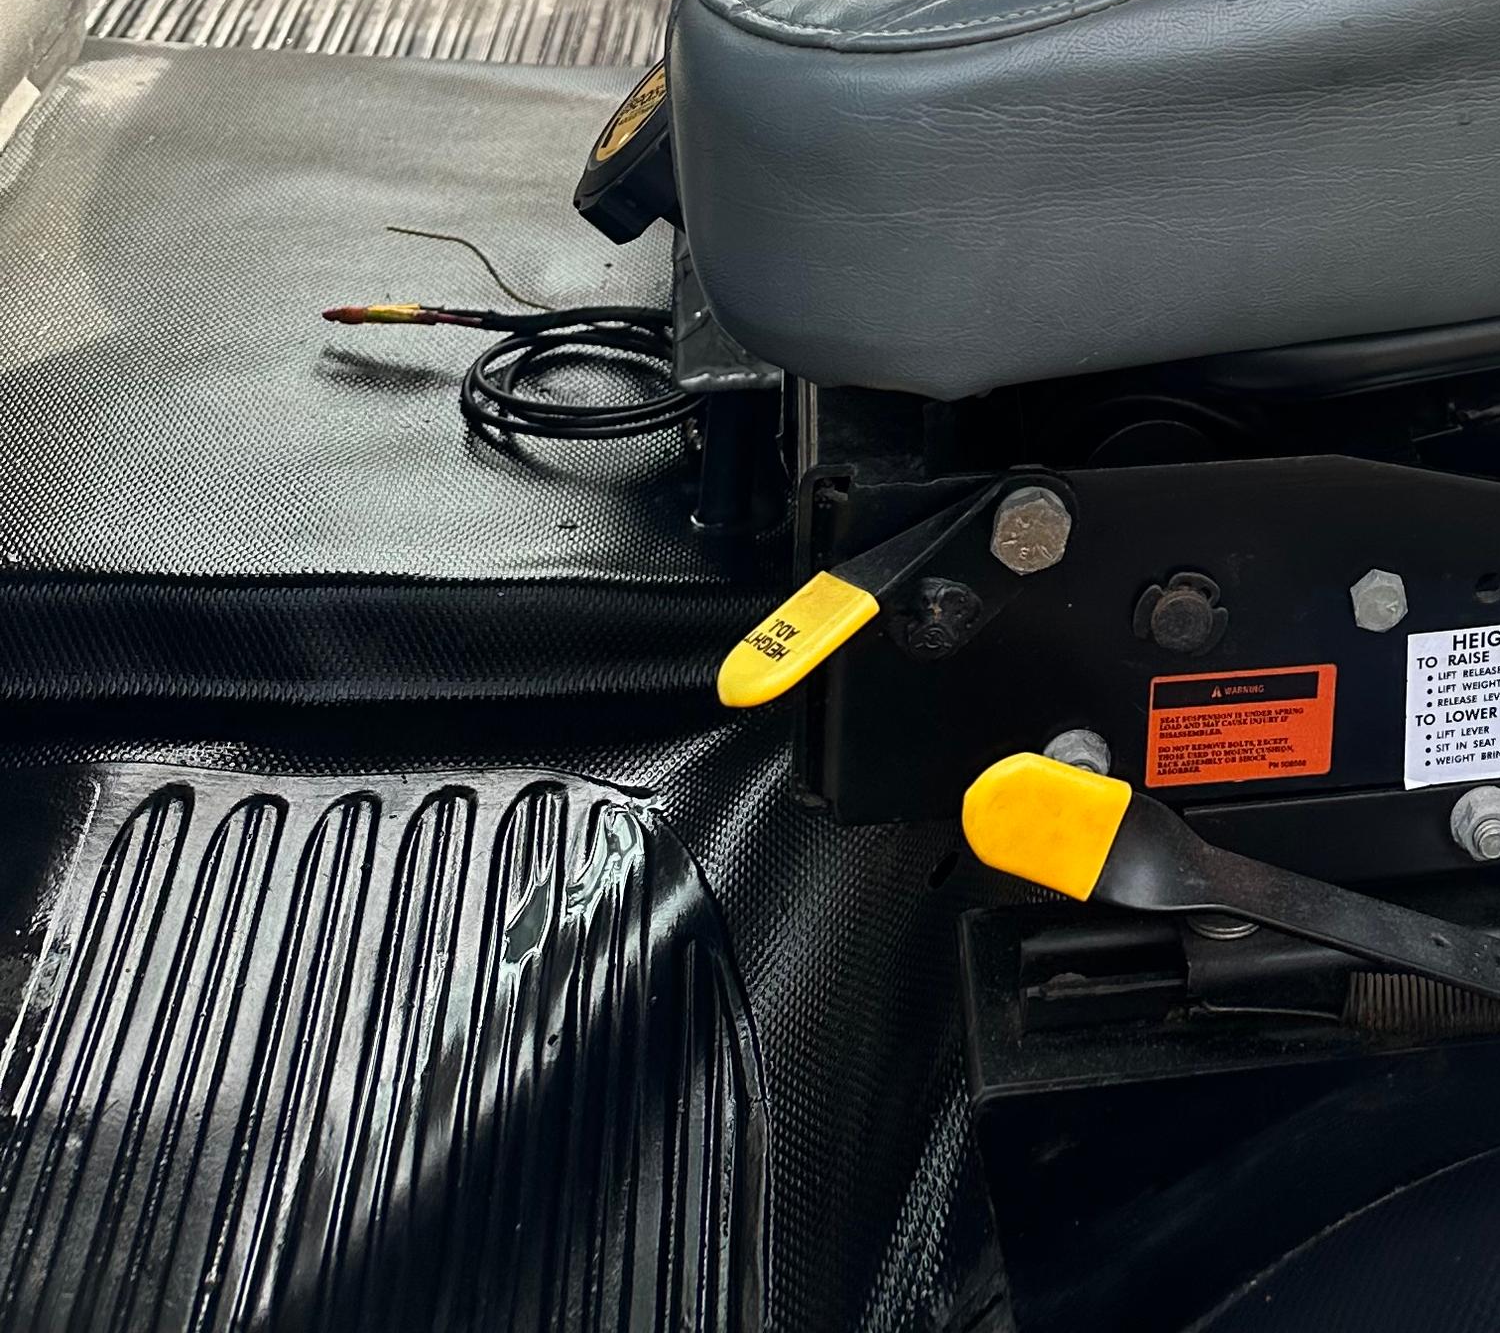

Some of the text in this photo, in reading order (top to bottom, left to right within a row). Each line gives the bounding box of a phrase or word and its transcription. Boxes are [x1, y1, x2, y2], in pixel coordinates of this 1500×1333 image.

[769, 618, 801, 642] ADJ.
[743, 630, 790, 662] HEIGHT
[1416, 651, 1490, 669] TO RAISE
[1438, 671, 1457, 681] LIFT
[1223, 684, 1265, 695] WARNING
[1437, 684, 1456, 694] LIFT
[1437, 694, 1477, 707] RELEASE
[1182, 712, 1233, 723] SUSPENSION
[1244, 709, 1273, 718] UNDER
[1274, 707, 1304, 716] SPRING
[1415, 707, 1498, 727] TO LOWER
[1159, 722, 1182, 731] LOAD
[1202, 719, 1220, 728] MAY
[1436, 726, 1490, 739] LIFT LEVER
[1172, 744, 1190, 753] NOT
[1436, 743, 1450, 753] SIT
[1456, 741, 1468, 751] IN
[1473, 738, 1496, 748] SEAT
[1436, 754, 1475, 766] WEIGHT
